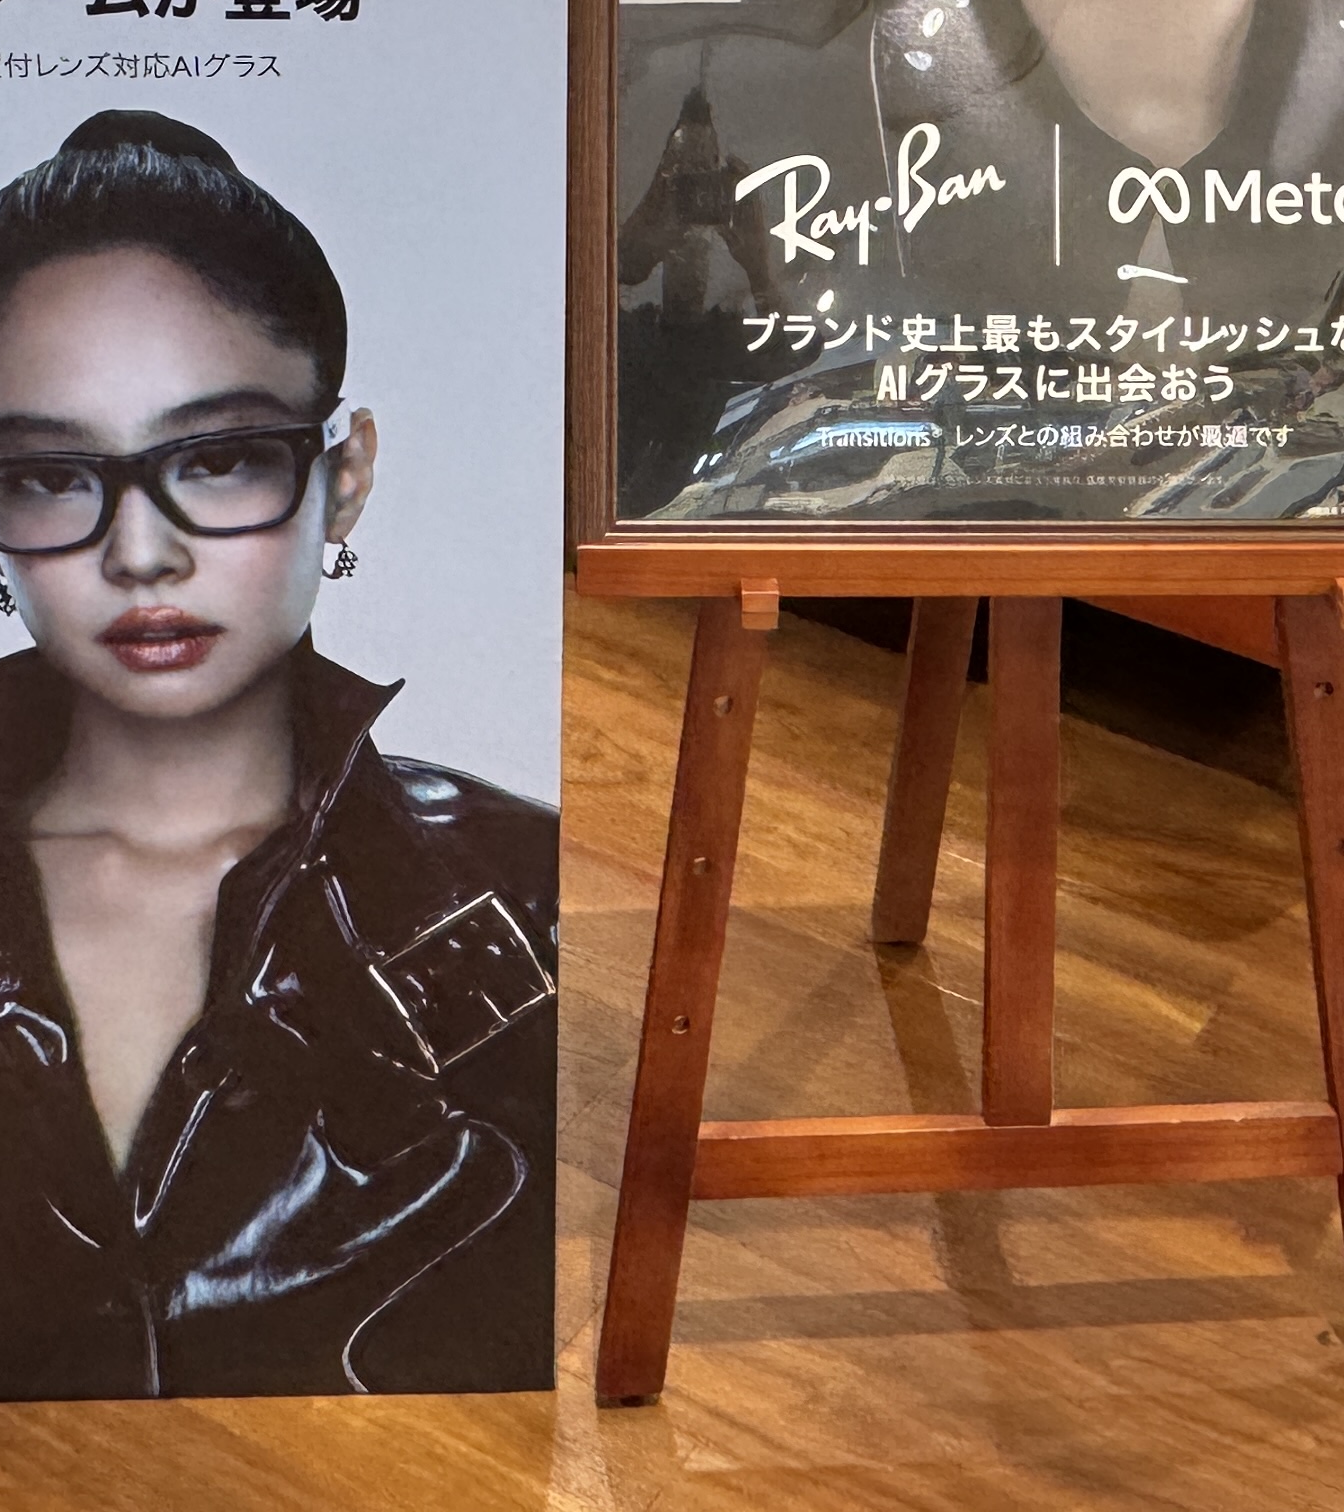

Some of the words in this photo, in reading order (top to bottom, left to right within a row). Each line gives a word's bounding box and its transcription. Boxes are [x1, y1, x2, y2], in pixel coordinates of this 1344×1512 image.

[735, 122, 1007, 267] Ray-Ban
[876, 362, 1235, 404] AIグラスに出会おう
